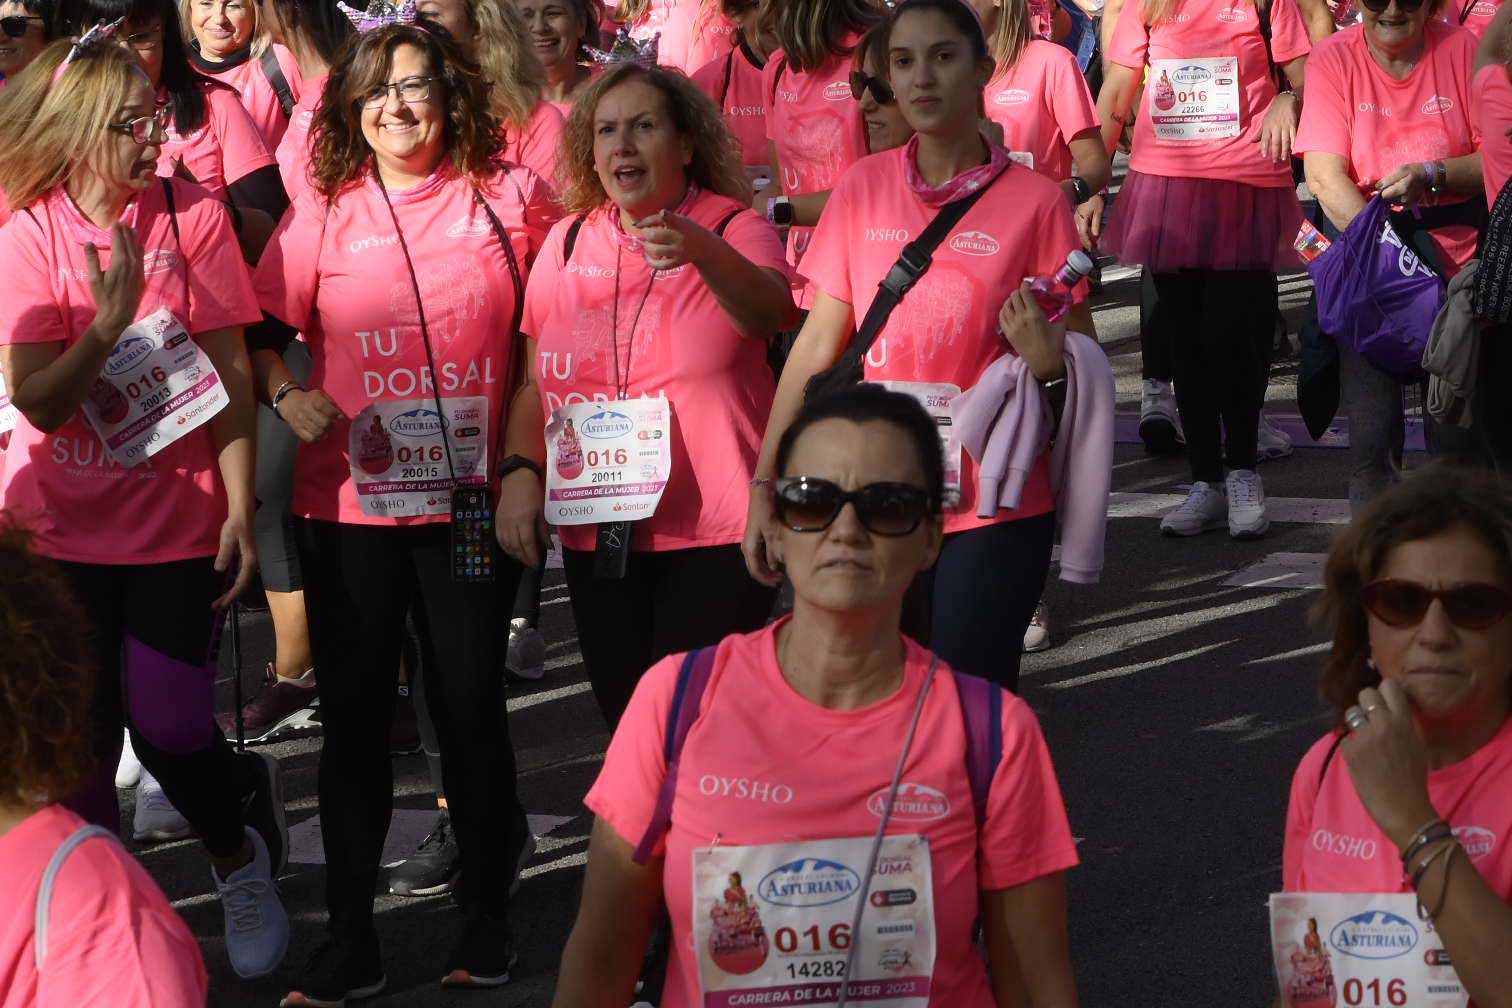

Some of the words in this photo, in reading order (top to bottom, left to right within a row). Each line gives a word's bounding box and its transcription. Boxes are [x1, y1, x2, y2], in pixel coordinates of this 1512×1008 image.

[1179, 91, 1207, 102] 016
[865, 228, 909, 242] YSHO
[953, 238, 996, 253] ASTURIANA
[567, 263, 614, 278] OYSHO
[355, 328, 397, 358] TU
[108, 343, 151, 372] ASTURIANA
[541, 352, 572, 380] TU
[127, 366, 166, 399] 016
[364, 357, 496, 397] DORSAL
[140, 387, 172, 413] 20013
[170, 392, 193, 408] MUJER
[186, 393, 220, 420] Santander
[585, 423, 630, 433] ASTURIANA
[126, 432, 161, 458] OYSHO
[398, 446, 443, 463] 016
[587, 449, 628, 467] 016
[402, 468, 438, 478] 20015
[592, 472, 623, 483] 20011
[370, 499, 405, 509] OYSHO
[559, 505, 594, 517] OYSHO
[700, 775, 793, 804] OYSHO
[1313, 828, 1377, 860] OYSHO
[767, 880, 853, 898] ASTURIANA
[775, 924, 851, 953] 016
[1337, 931, 1413, 949] ASTURIANA
[787, 961, 846, 978] 14282
[728, 990, 788, 1006] CARRERA
[793, 989, 812, 1000] DE
[816, 987, 832, 998] LA
[1343, 978, 1408, 1008] 016
